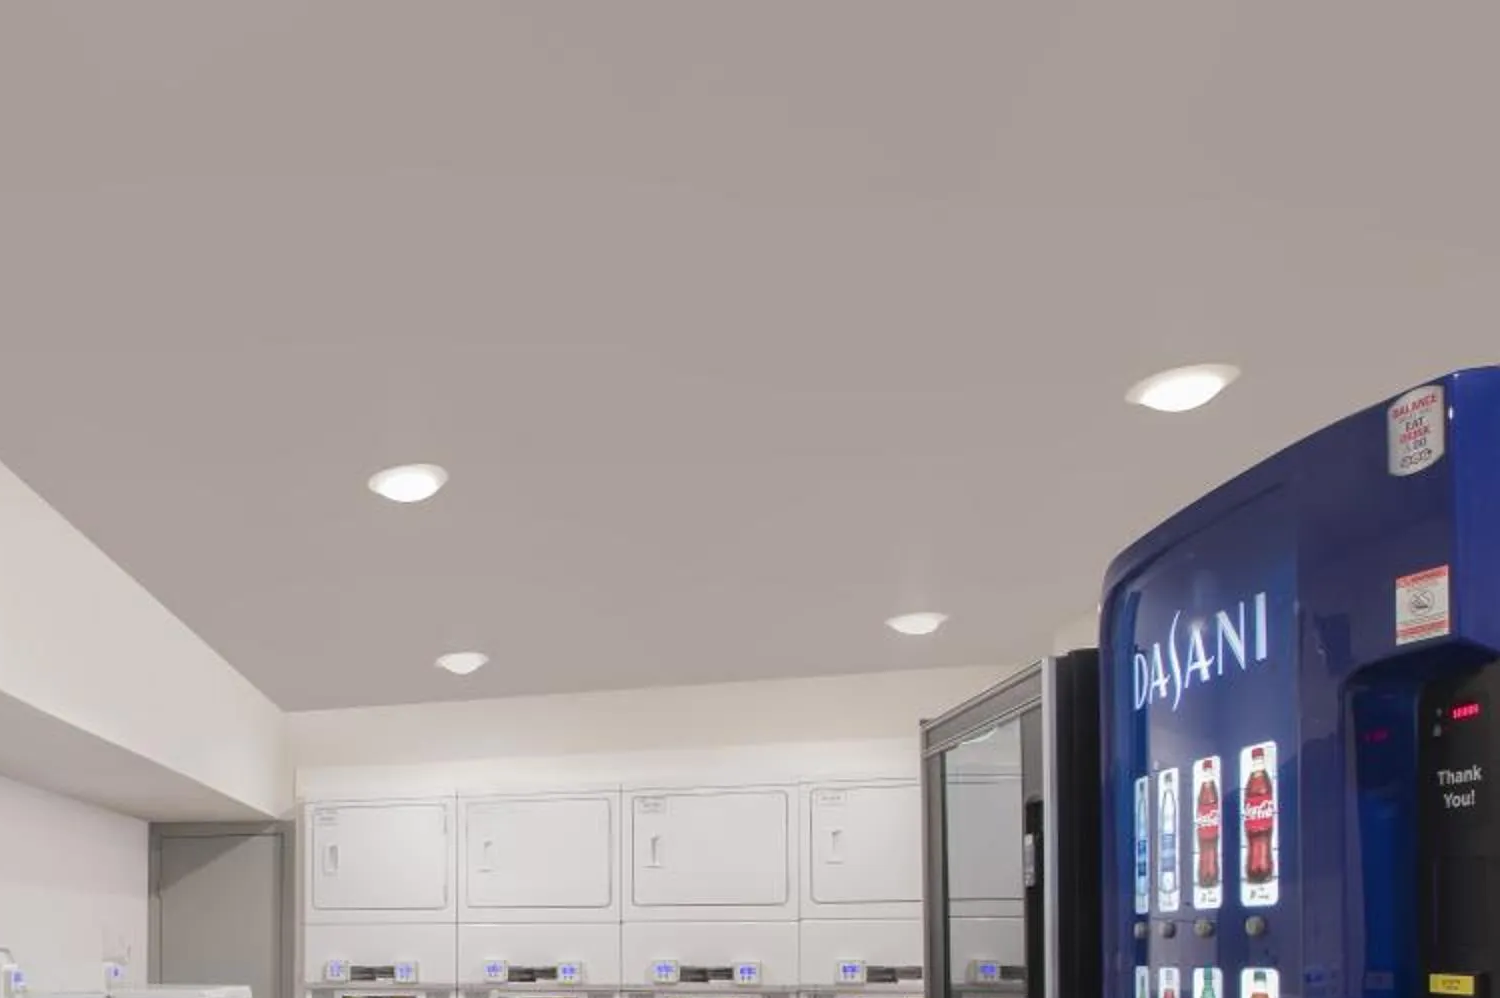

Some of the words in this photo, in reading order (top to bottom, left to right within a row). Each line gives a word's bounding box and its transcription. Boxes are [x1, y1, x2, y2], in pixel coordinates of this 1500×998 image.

[1134, 591, 1267, 712] DASANI
[1436, 764, 1482, 785] Thank
[1443, 788, 1476, 809] You!
